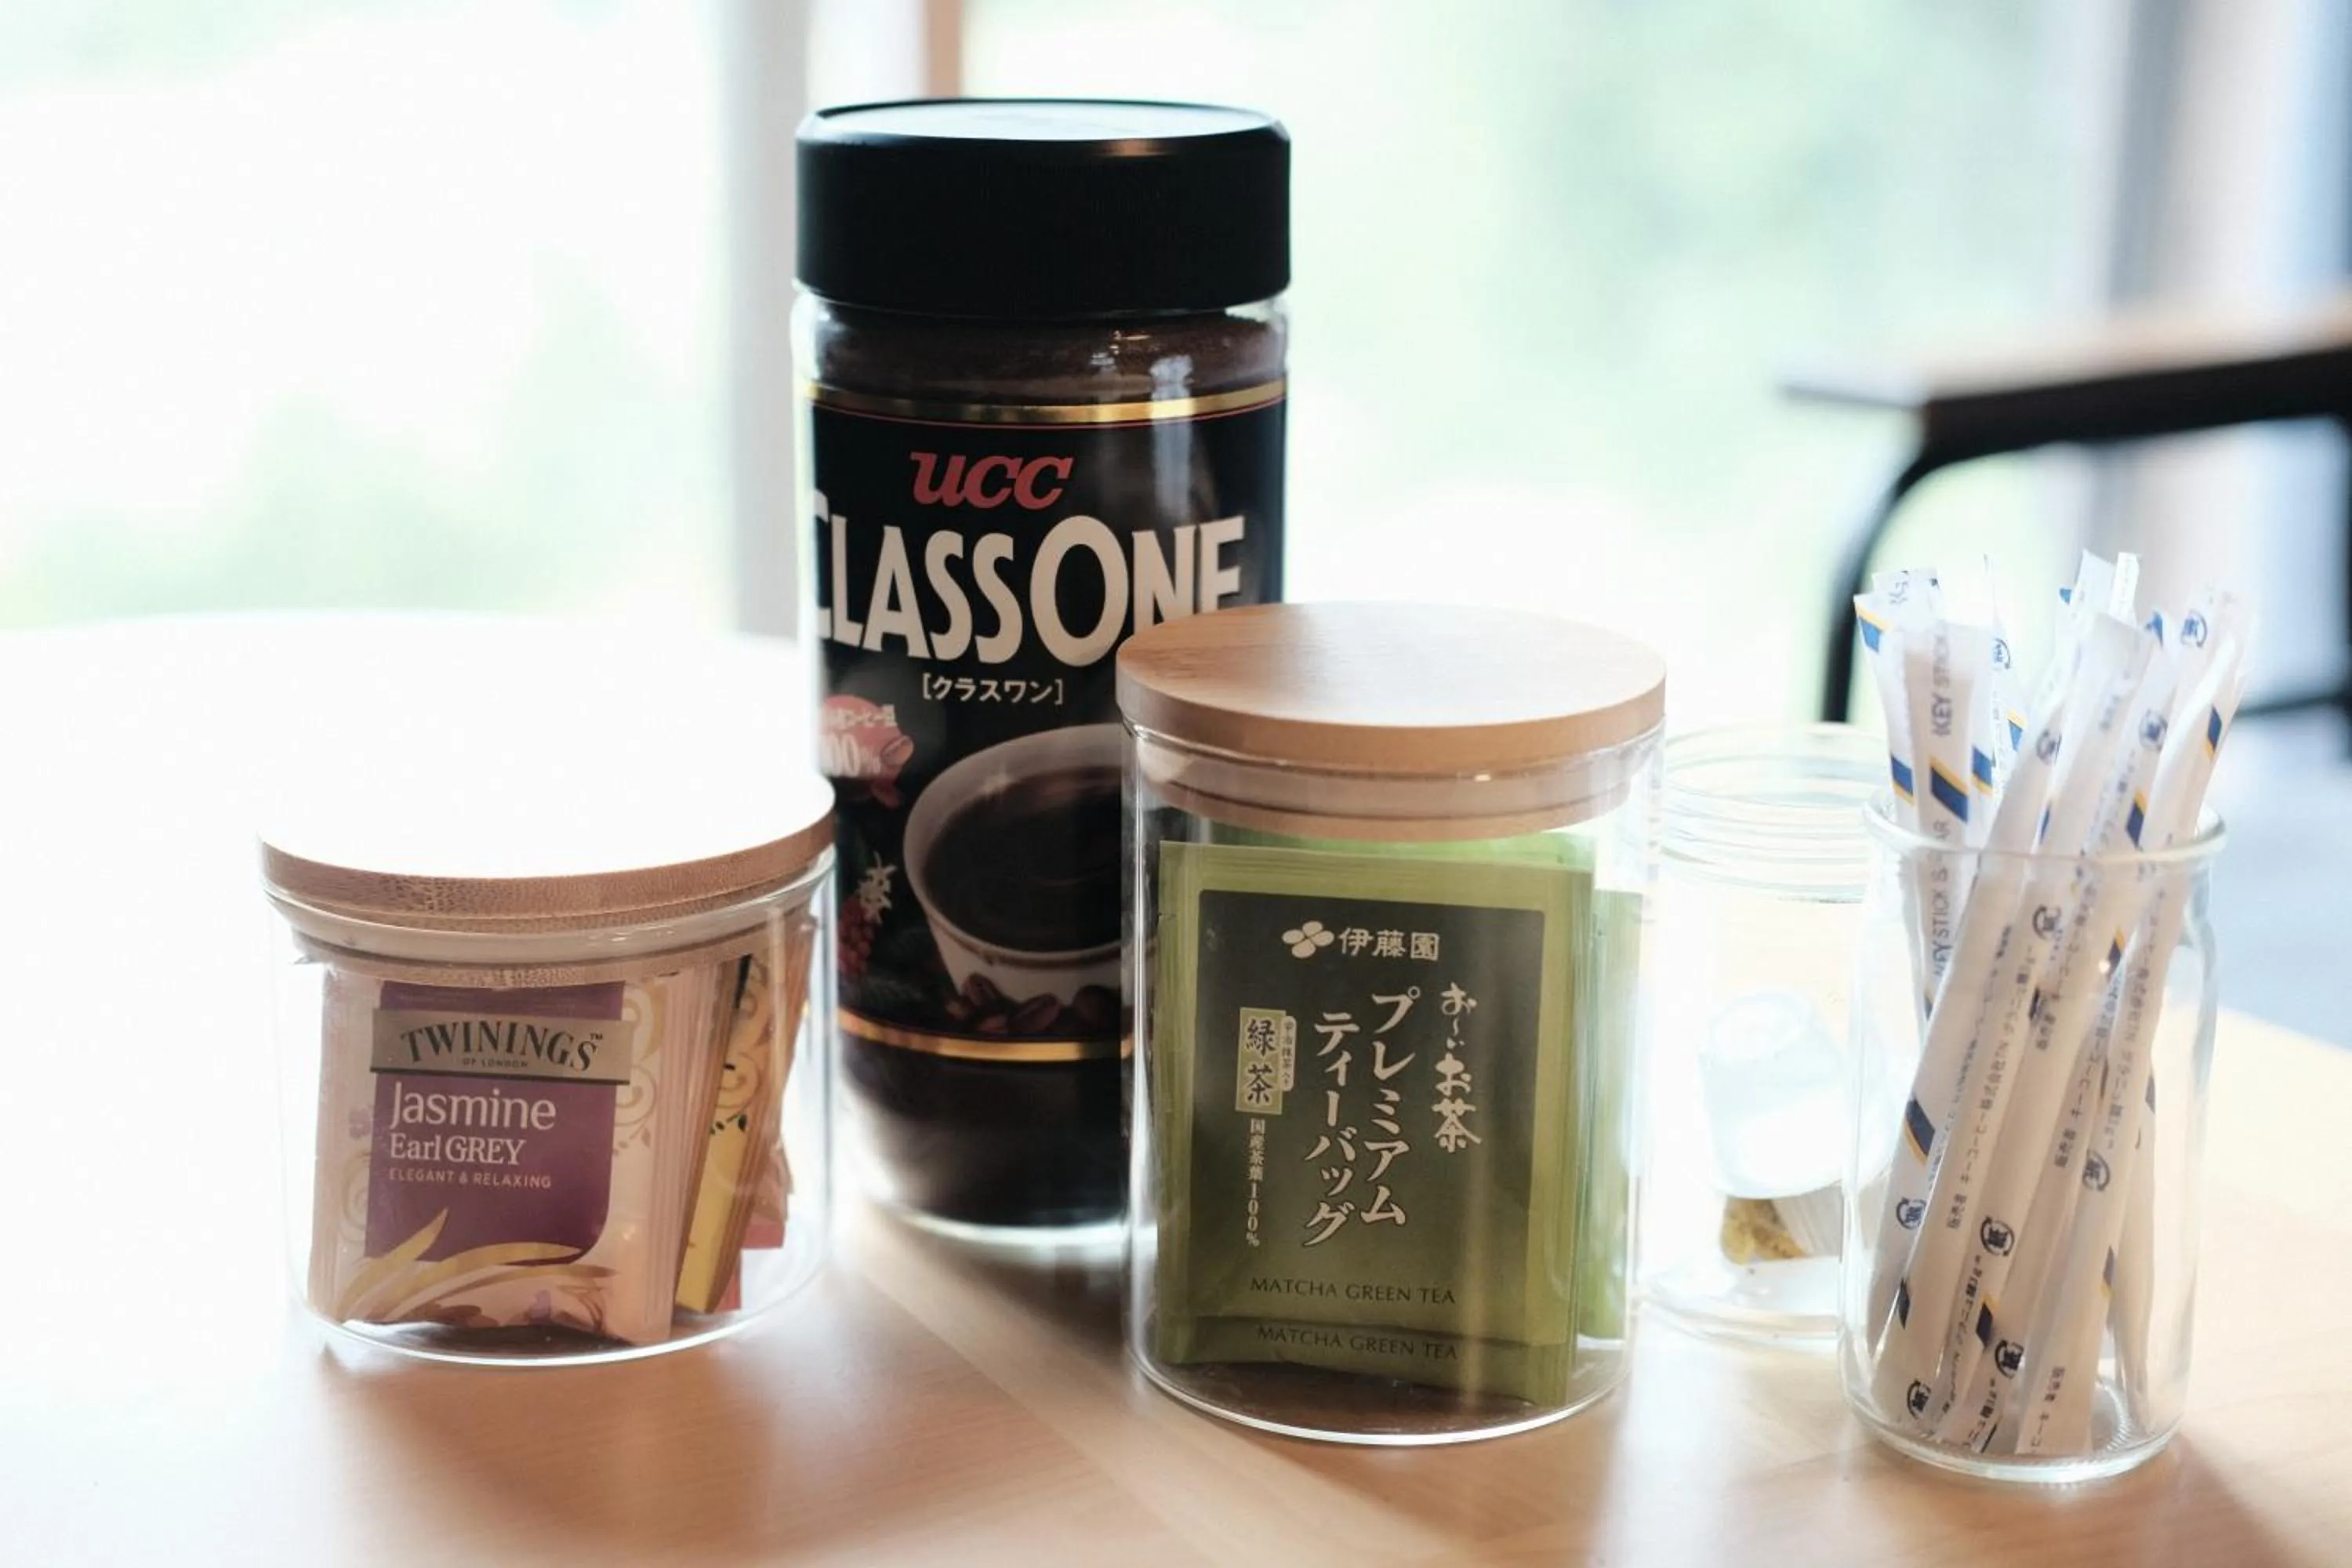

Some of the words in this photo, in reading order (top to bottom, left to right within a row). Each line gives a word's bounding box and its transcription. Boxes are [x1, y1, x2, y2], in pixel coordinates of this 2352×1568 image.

[1338, 927, 1440, 961] 伊藤園
[1245, 1018, 1276, 1105] 緑茶
[389, 1080, 557, 1131] Jasmine
[1360, 985, 1421, 1226] プレミアム
[1303, 1012, 1360, 1247] ティーバッグ
[390, 1133, 441, 1161] Earl
[445, 1134, 527, 1166] GREY
[389, 1167, 455, 1182] ELEGANT
[459, 1173, 469, 1185] &
[474, 1173, 552, 1189] RELAXING
[1250, 1277, 1338, 1298] MATCHA
[1345, 1283, 1411, 1301] GREEN
[1417, 1287, 1456, 1305] TEA
[1258, 1323, 1344, 1348] MATCHA
[1349, 1336, 1414, 1356] GREEN
[1422, 1341, 1459, 1361] TEA
